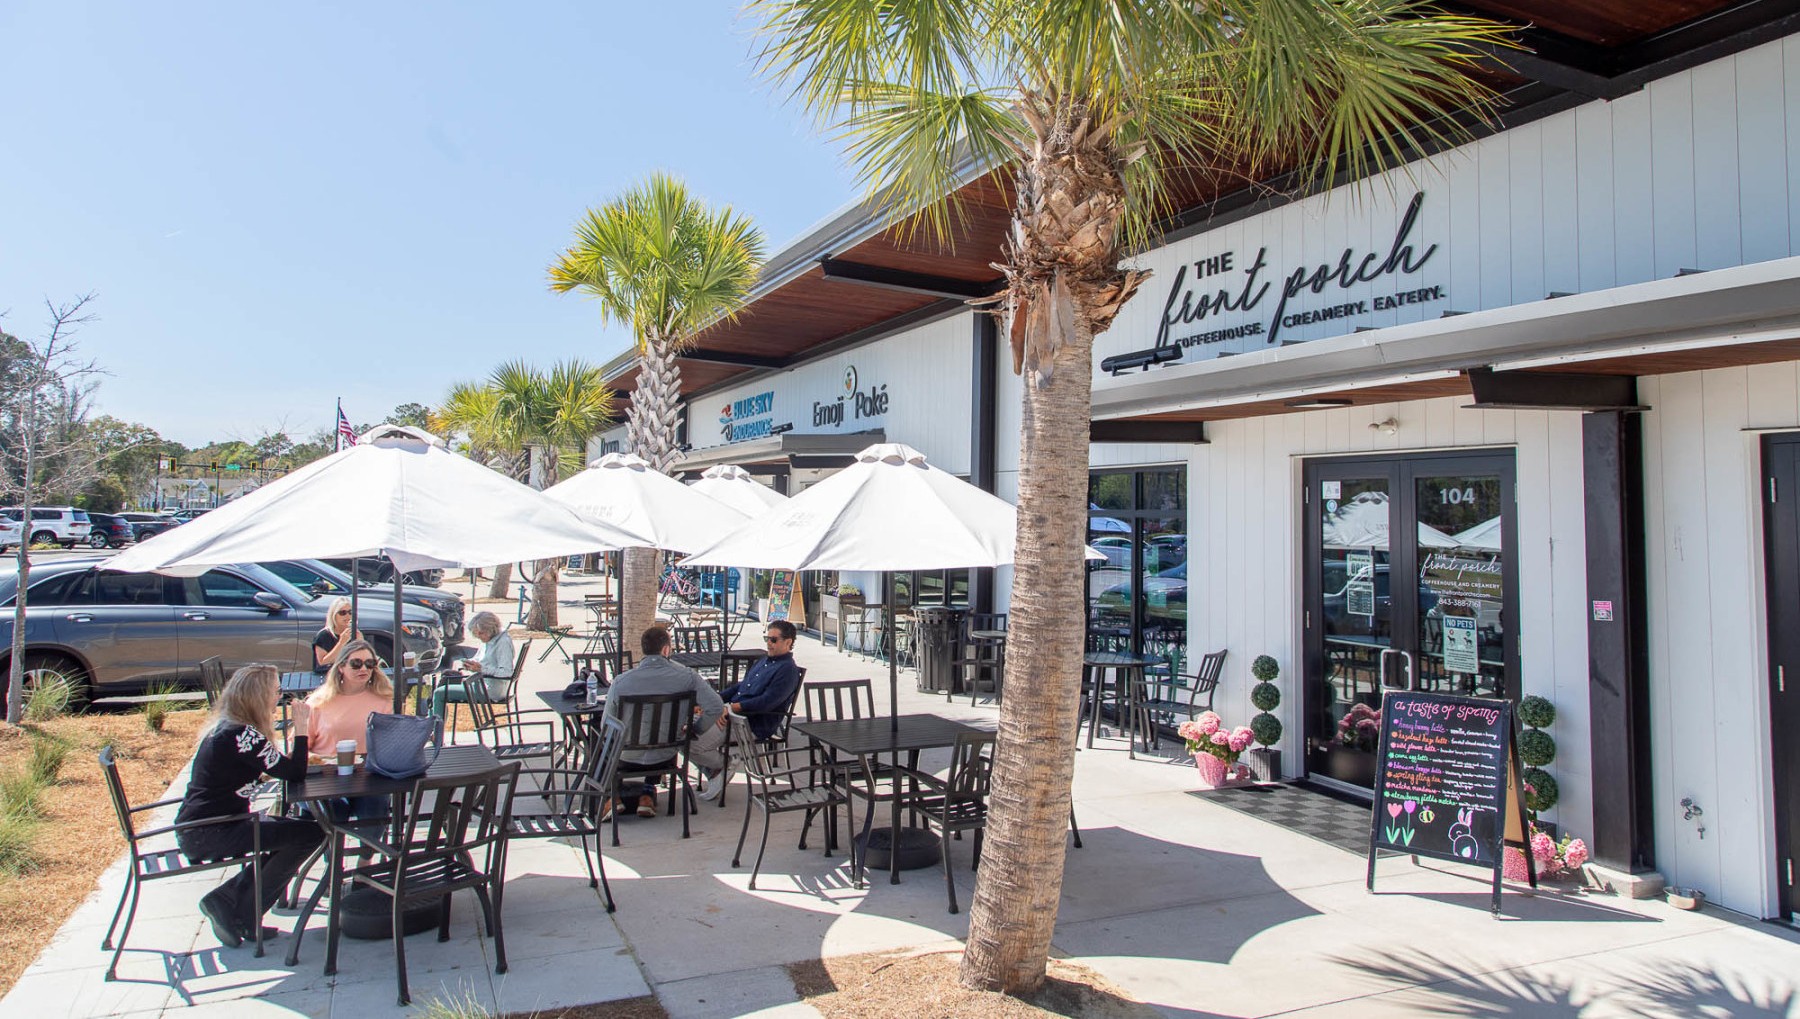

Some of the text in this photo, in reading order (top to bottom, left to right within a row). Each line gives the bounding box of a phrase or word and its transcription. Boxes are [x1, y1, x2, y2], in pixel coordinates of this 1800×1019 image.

[1156, 191, 1438, 349] front porch
[1194, 252, 1233, 279] THE
[1282, 300, 1369, 329] CREAMERY.
[1373, 284, 1447, 311] EATERY.
[733, 391, 775, 420] BLUE SKY
[812, 383, 889, 428] Emoji Poké
[1439, 487, 1476, 505] 104
[1420, 552, 1500, 580] front porch
[1421, 579, 1457, 587] COFFEEHOUSE
[1446, 618, 1474, 629] NO PETS
[1394, 700, 1500, 725] a taste of spring
